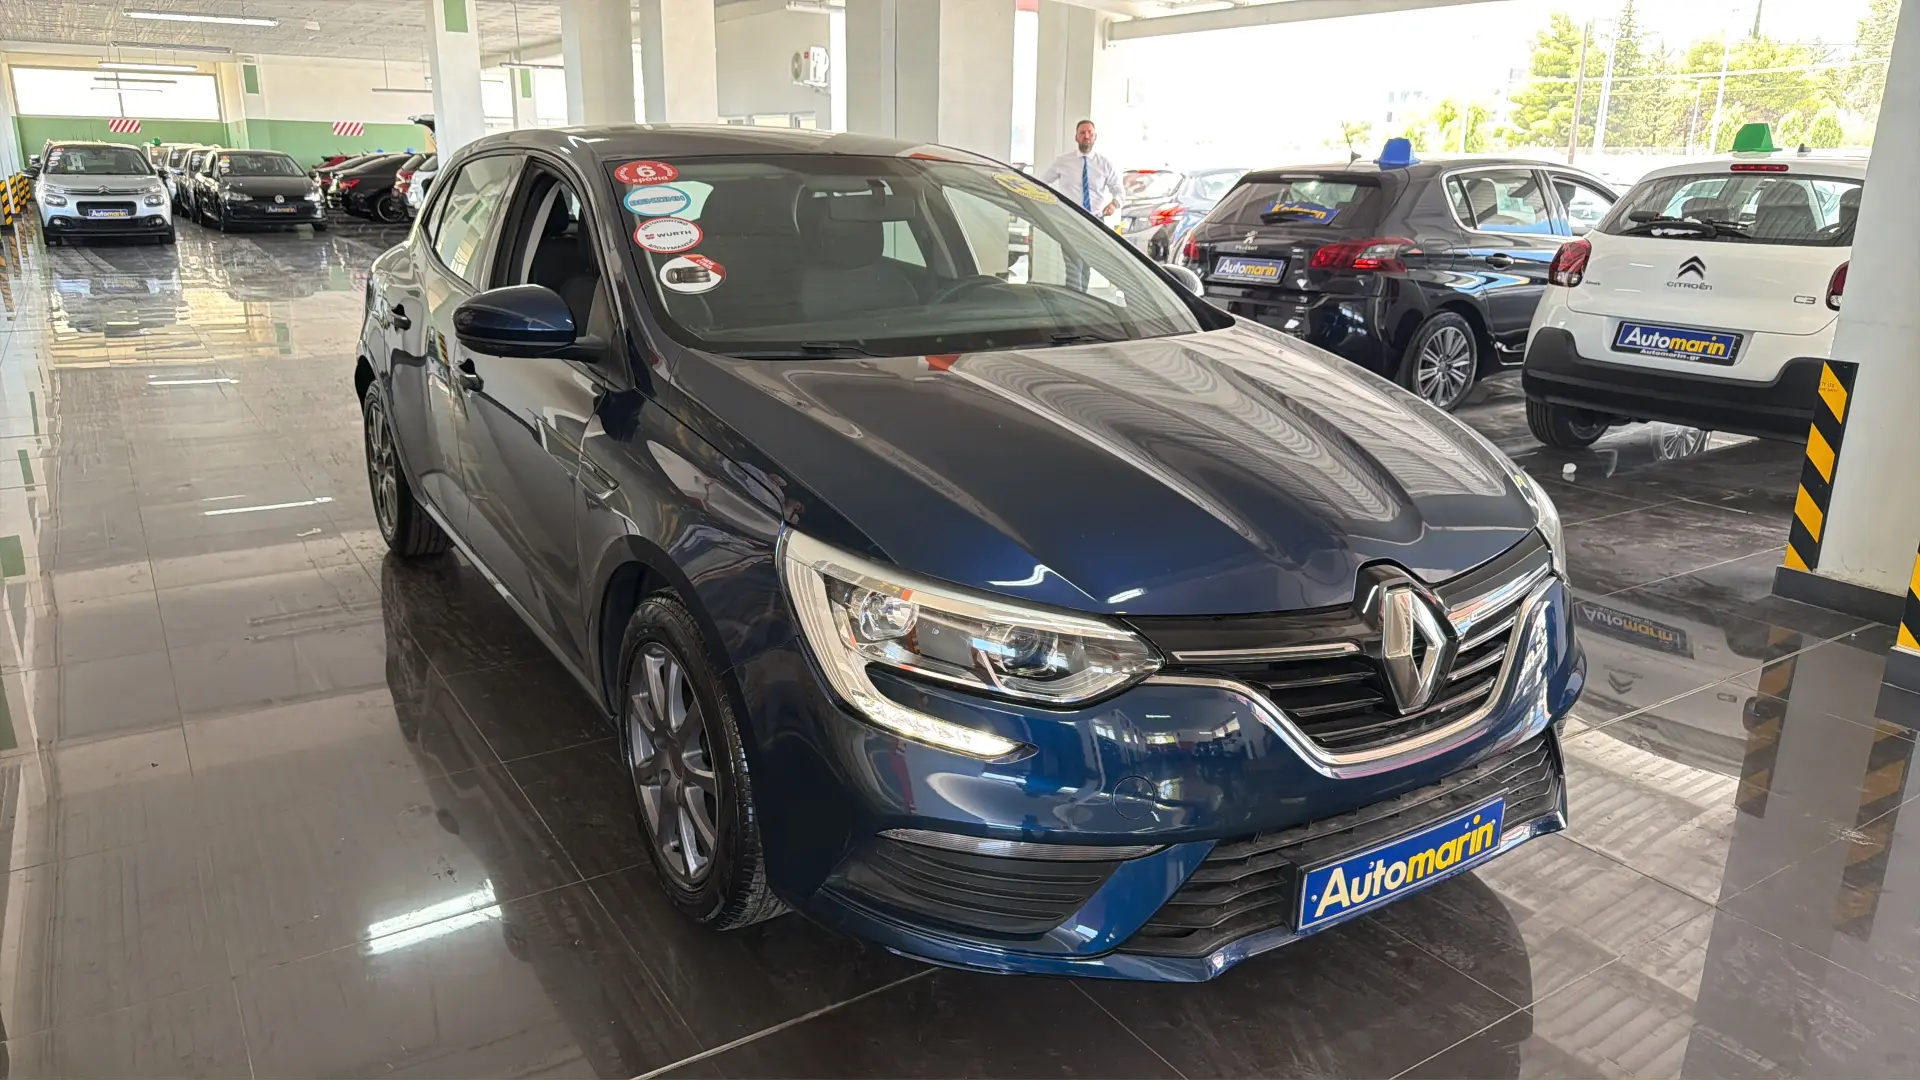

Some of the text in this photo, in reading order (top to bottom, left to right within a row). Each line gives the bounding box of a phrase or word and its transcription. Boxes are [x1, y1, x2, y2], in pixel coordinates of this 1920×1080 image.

[636, 165, 656, 178] 6
[91, 209, 127, 217] Automarin
[1219, 259, 1277, 276] Automarin
[1793, 295, 1817, 305] C3
[1624, 326, 1726, 356] Automarin
[1640, 348, 1701, 361] Automarin.gr
[1314, 814, 1494, 918] Automarin
